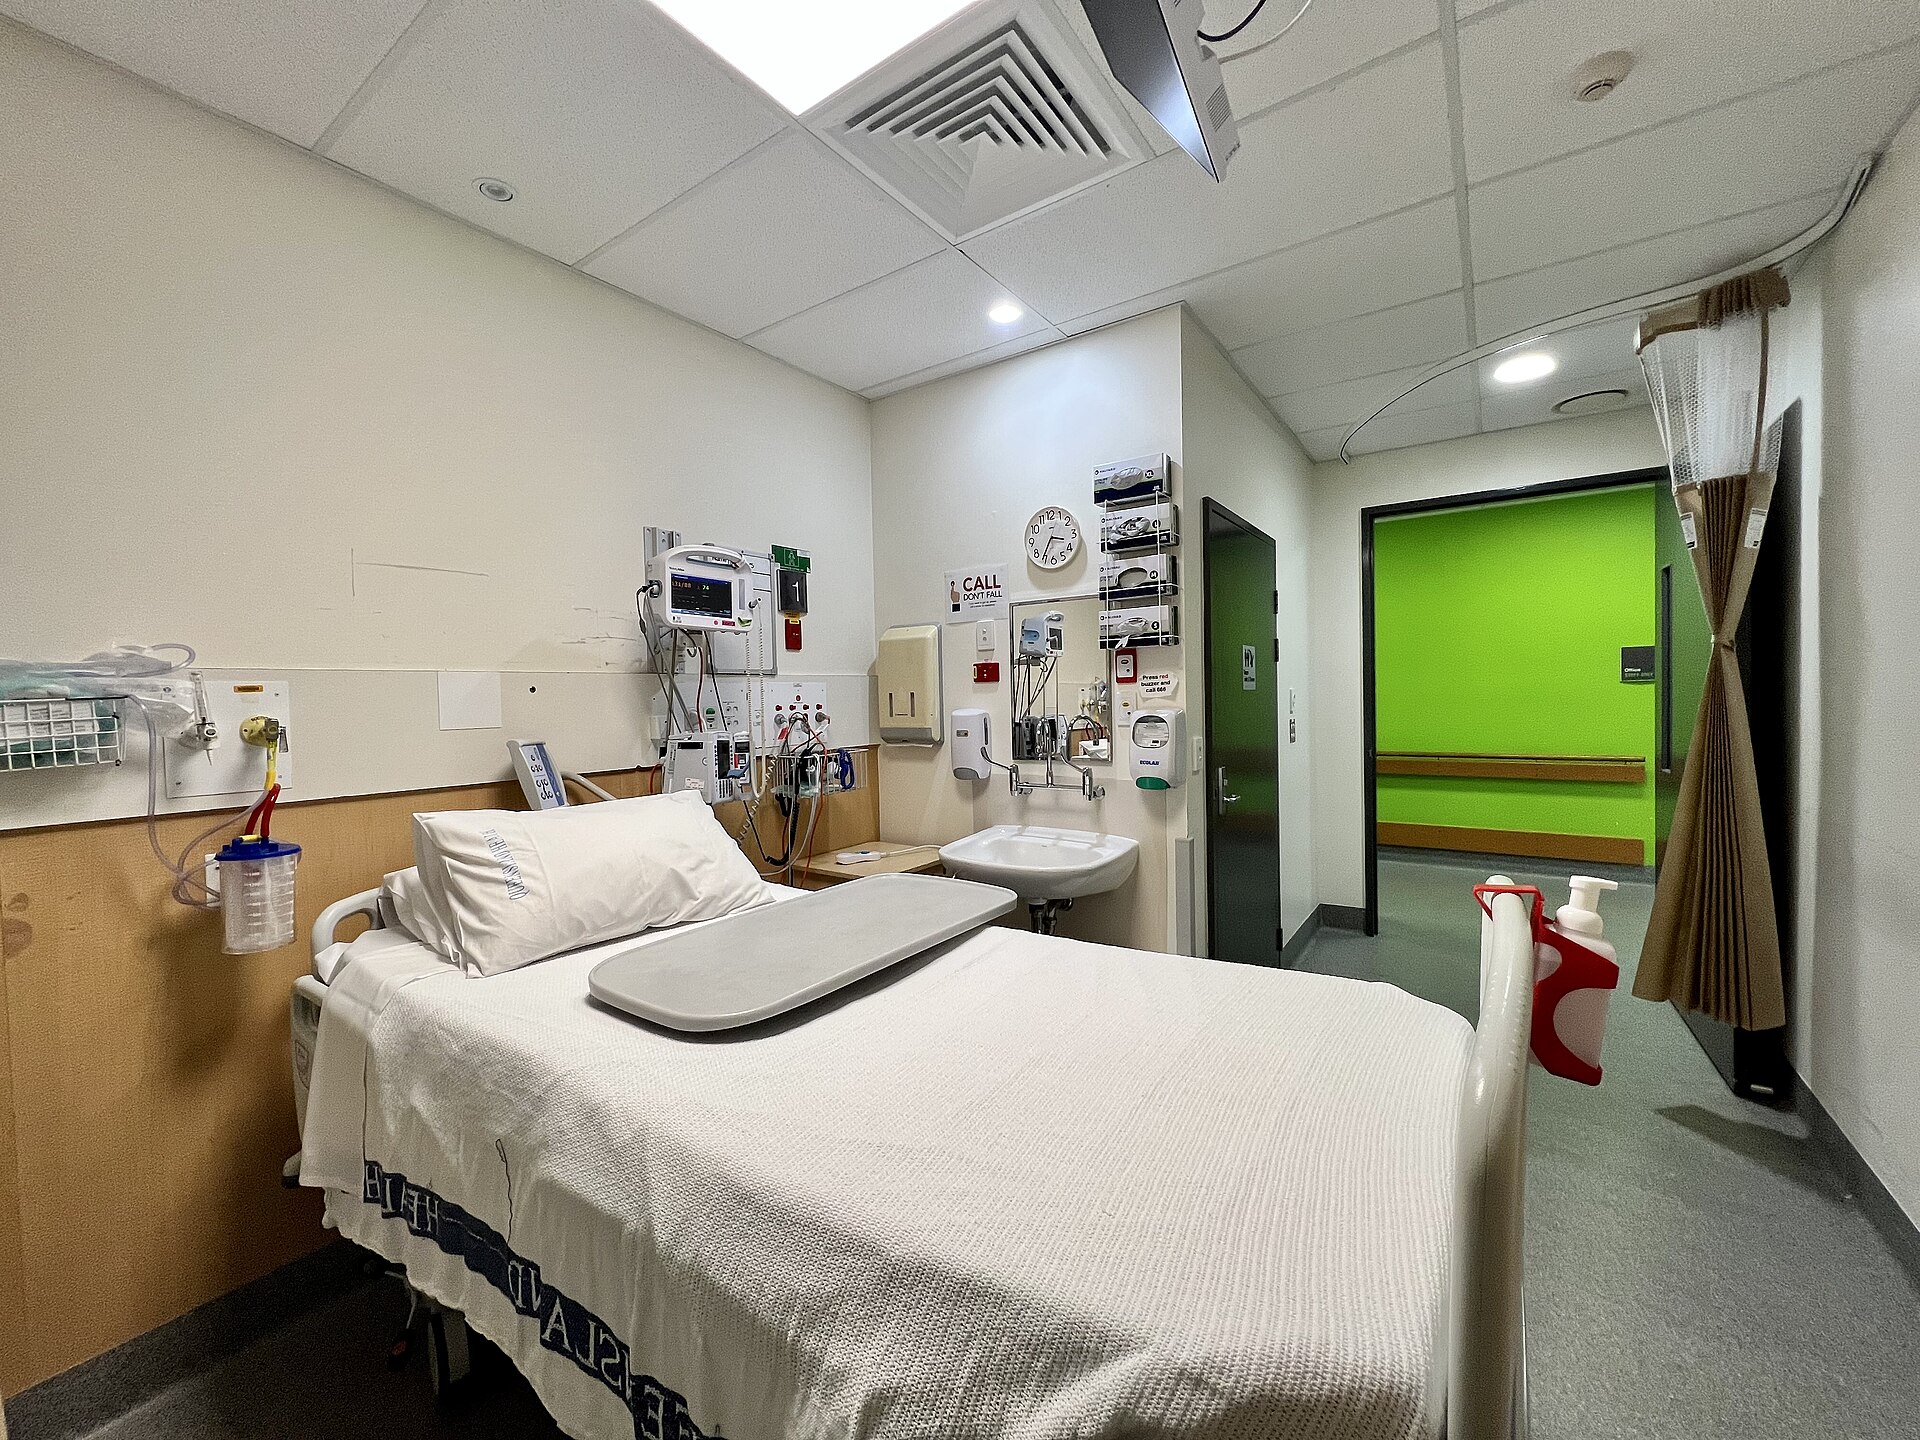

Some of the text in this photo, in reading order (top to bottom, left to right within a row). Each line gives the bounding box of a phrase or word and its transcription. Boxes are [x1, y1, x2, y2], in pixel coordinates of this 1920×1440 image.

[1039, 515, 1045, 524] 11
[1046, 510, 1055, 520] 12
[1058, 511, 1062, 520] 1
[1064, 516, 1071, 526] 2
[1031, 524, 1040, 534] 10
[1071, 529, 1077, 539] 3
[1029, 538, 1035, 547] 9
[1066, 543, 1073, 552] 4
[1034, 549, 1040, 558] 8
[1060, 551, 1066, 561] 5
[1050, 556, 1058, 565] 6
[963, 574, 1001, 592] CALL
[792, 581, 800, 602] 1
[964, 590, 1002, 601] DON'T FALL
